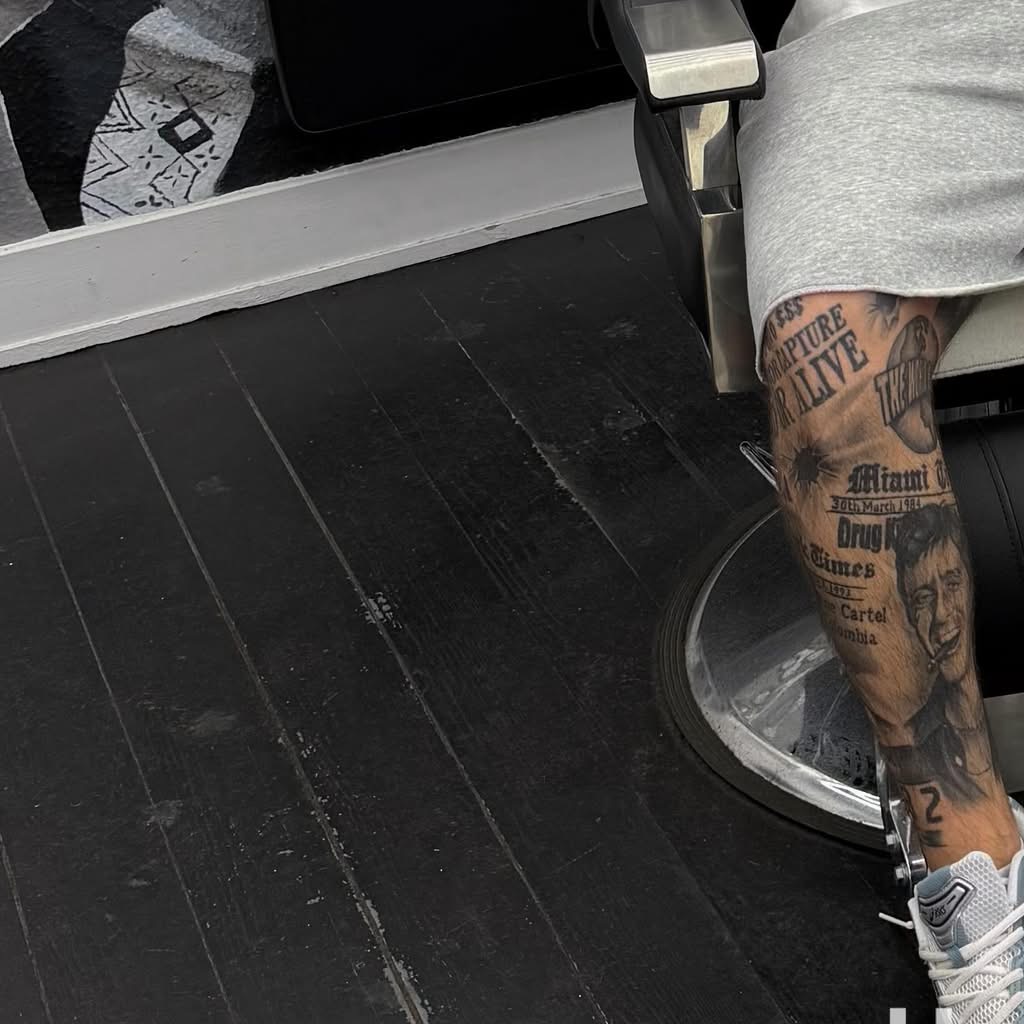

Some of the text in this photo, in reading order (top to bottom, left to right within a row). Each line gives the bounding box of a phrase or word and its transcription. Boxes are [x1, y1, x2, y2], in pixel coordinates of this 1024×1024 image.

[846, 463, 929, 494] Miami
[862, 499, 896, 514] March
[838, 516, 882, 554] Drug
[841, 604, 887, 624] Cartel
